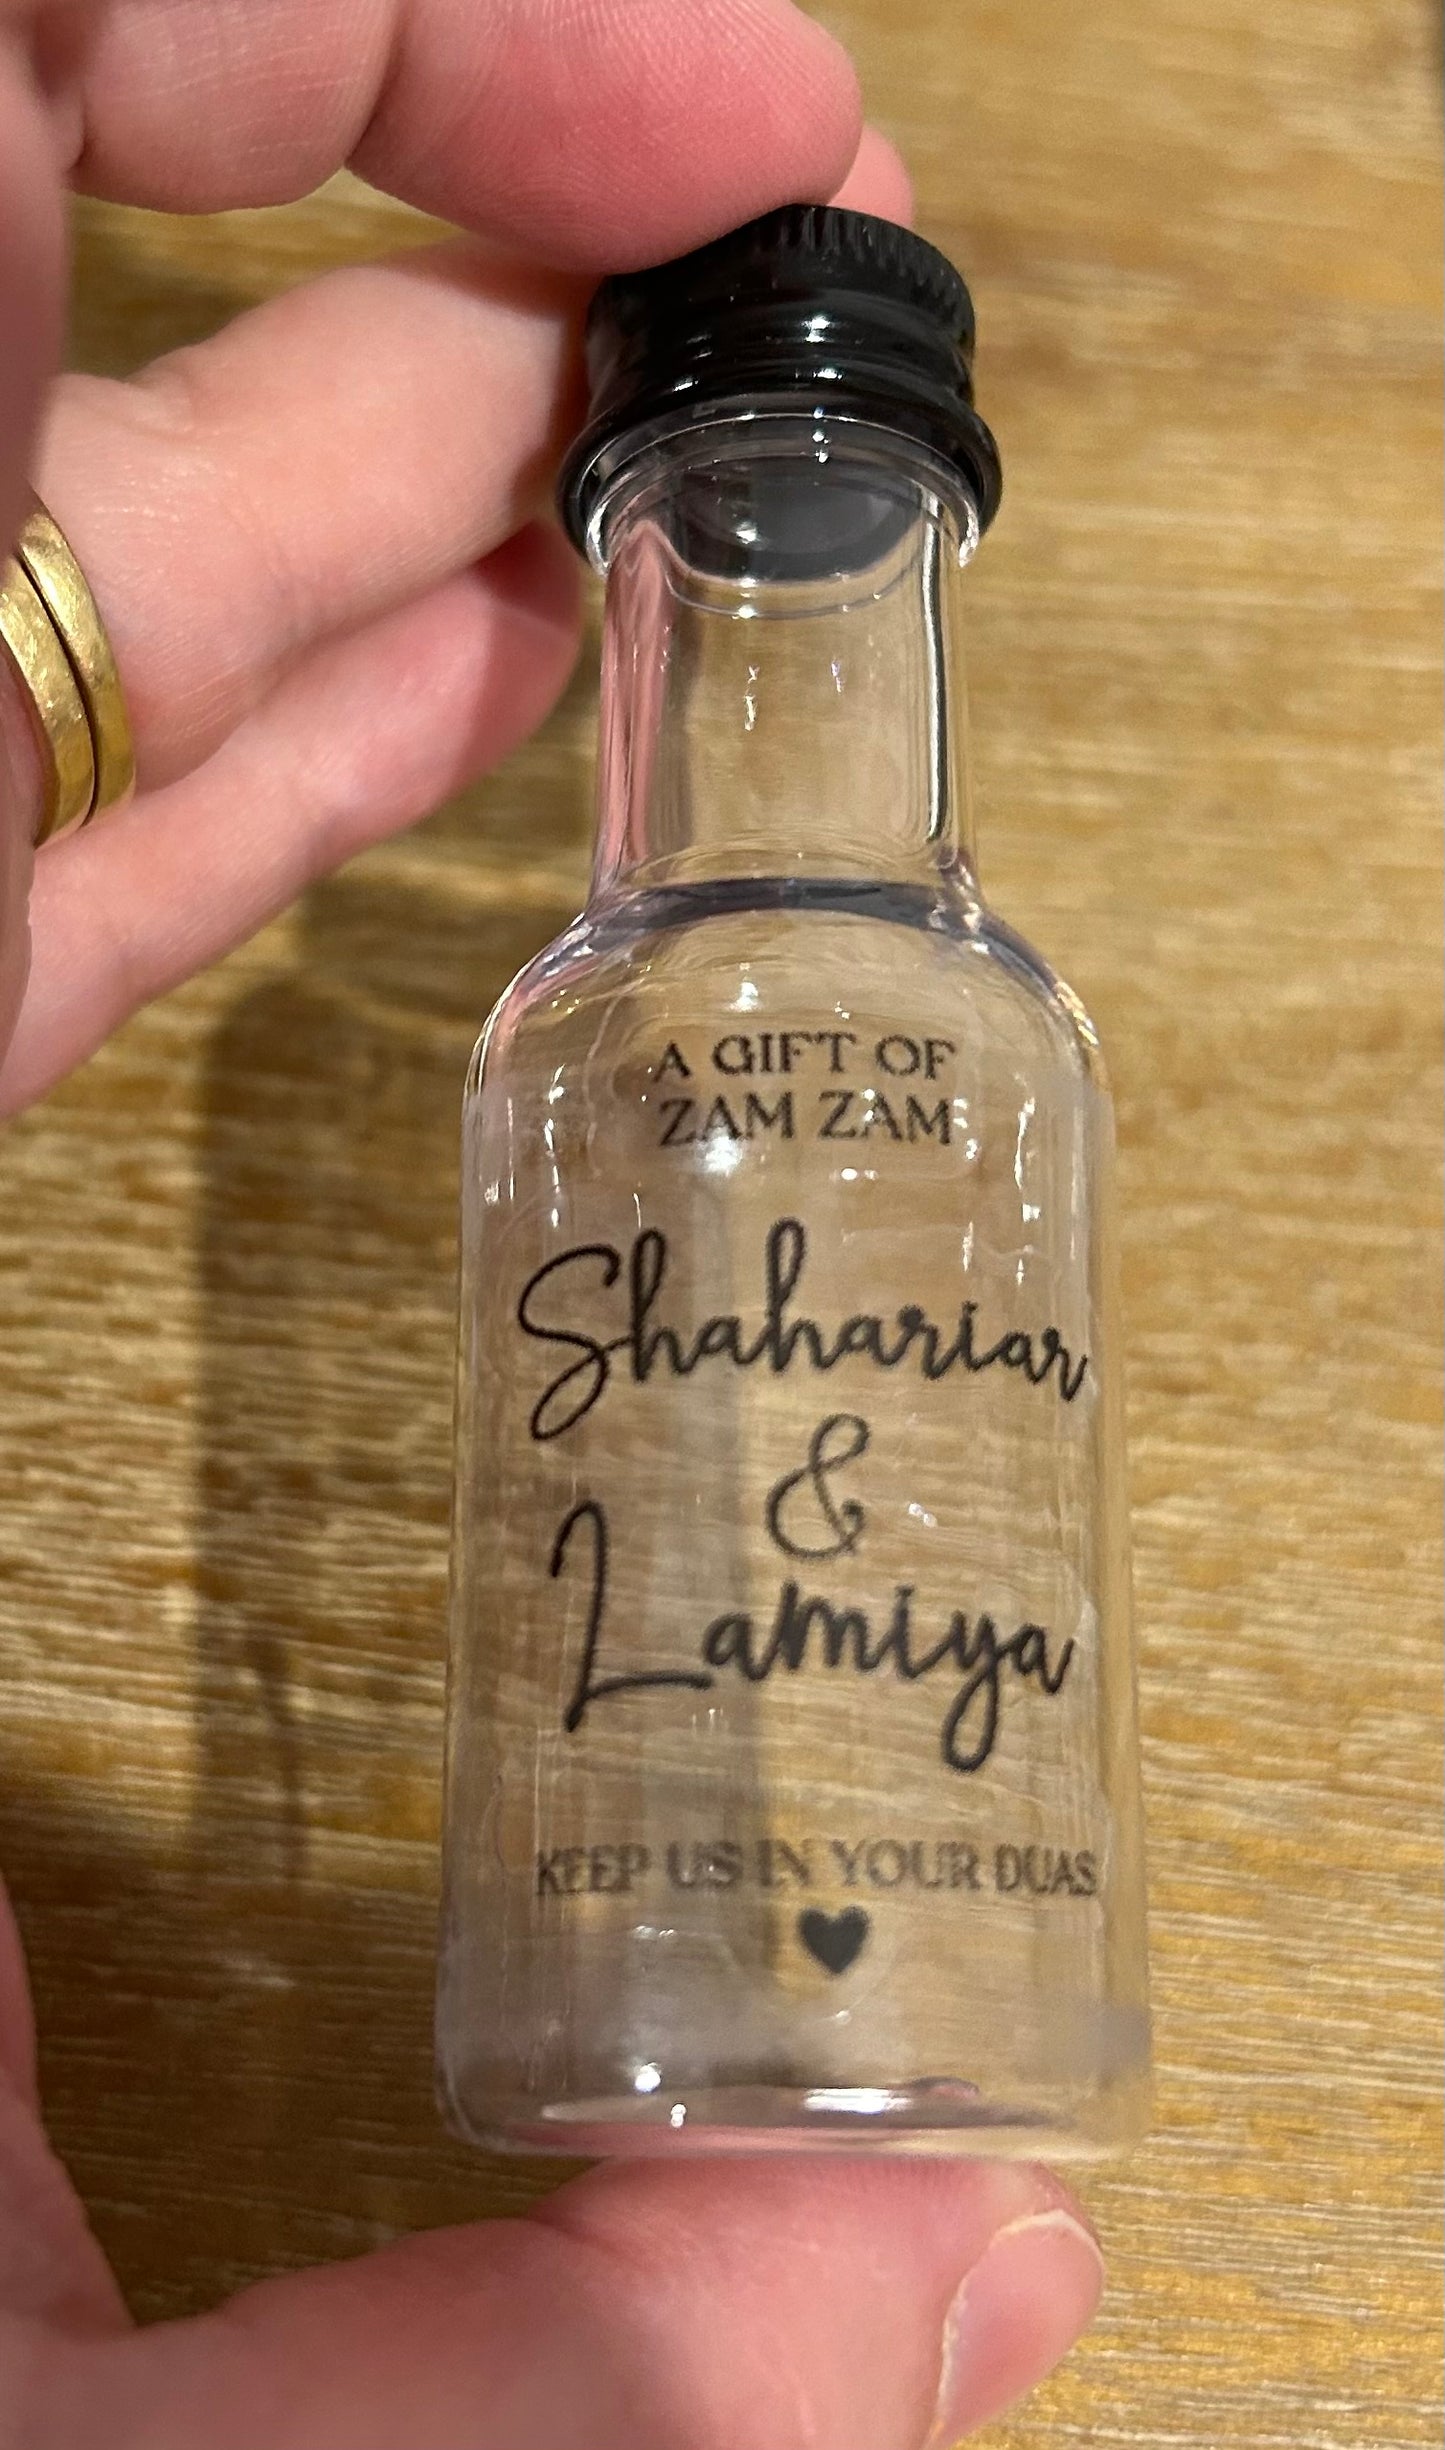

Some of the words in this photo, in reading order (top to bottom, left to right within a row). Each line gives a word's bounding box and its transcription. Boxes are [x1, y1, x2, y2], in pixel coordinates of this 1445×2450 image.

[653, 1040, 692, 1083] A
[712, 1031, 857, 1076] GIFT
[874, 1034, 956, 1080] OF
[659, 1091, 796, 1147] ZAM
[818, 1089, 951, 1146] ZAM
[518, 1216, 1088, 1441] Shahariar
[766, 1413, 870, 1561] &
[549, 1500, 1075, 1773] Lamiya
[537, 1843, 651, 1896] KEEP
[665, 1840, 739, 1893] US
[757, 1839, 810, 1889] IN
[828, 1839, 982, 1892] YOUR
[994, 1842, 1097, 1897] DUAS
